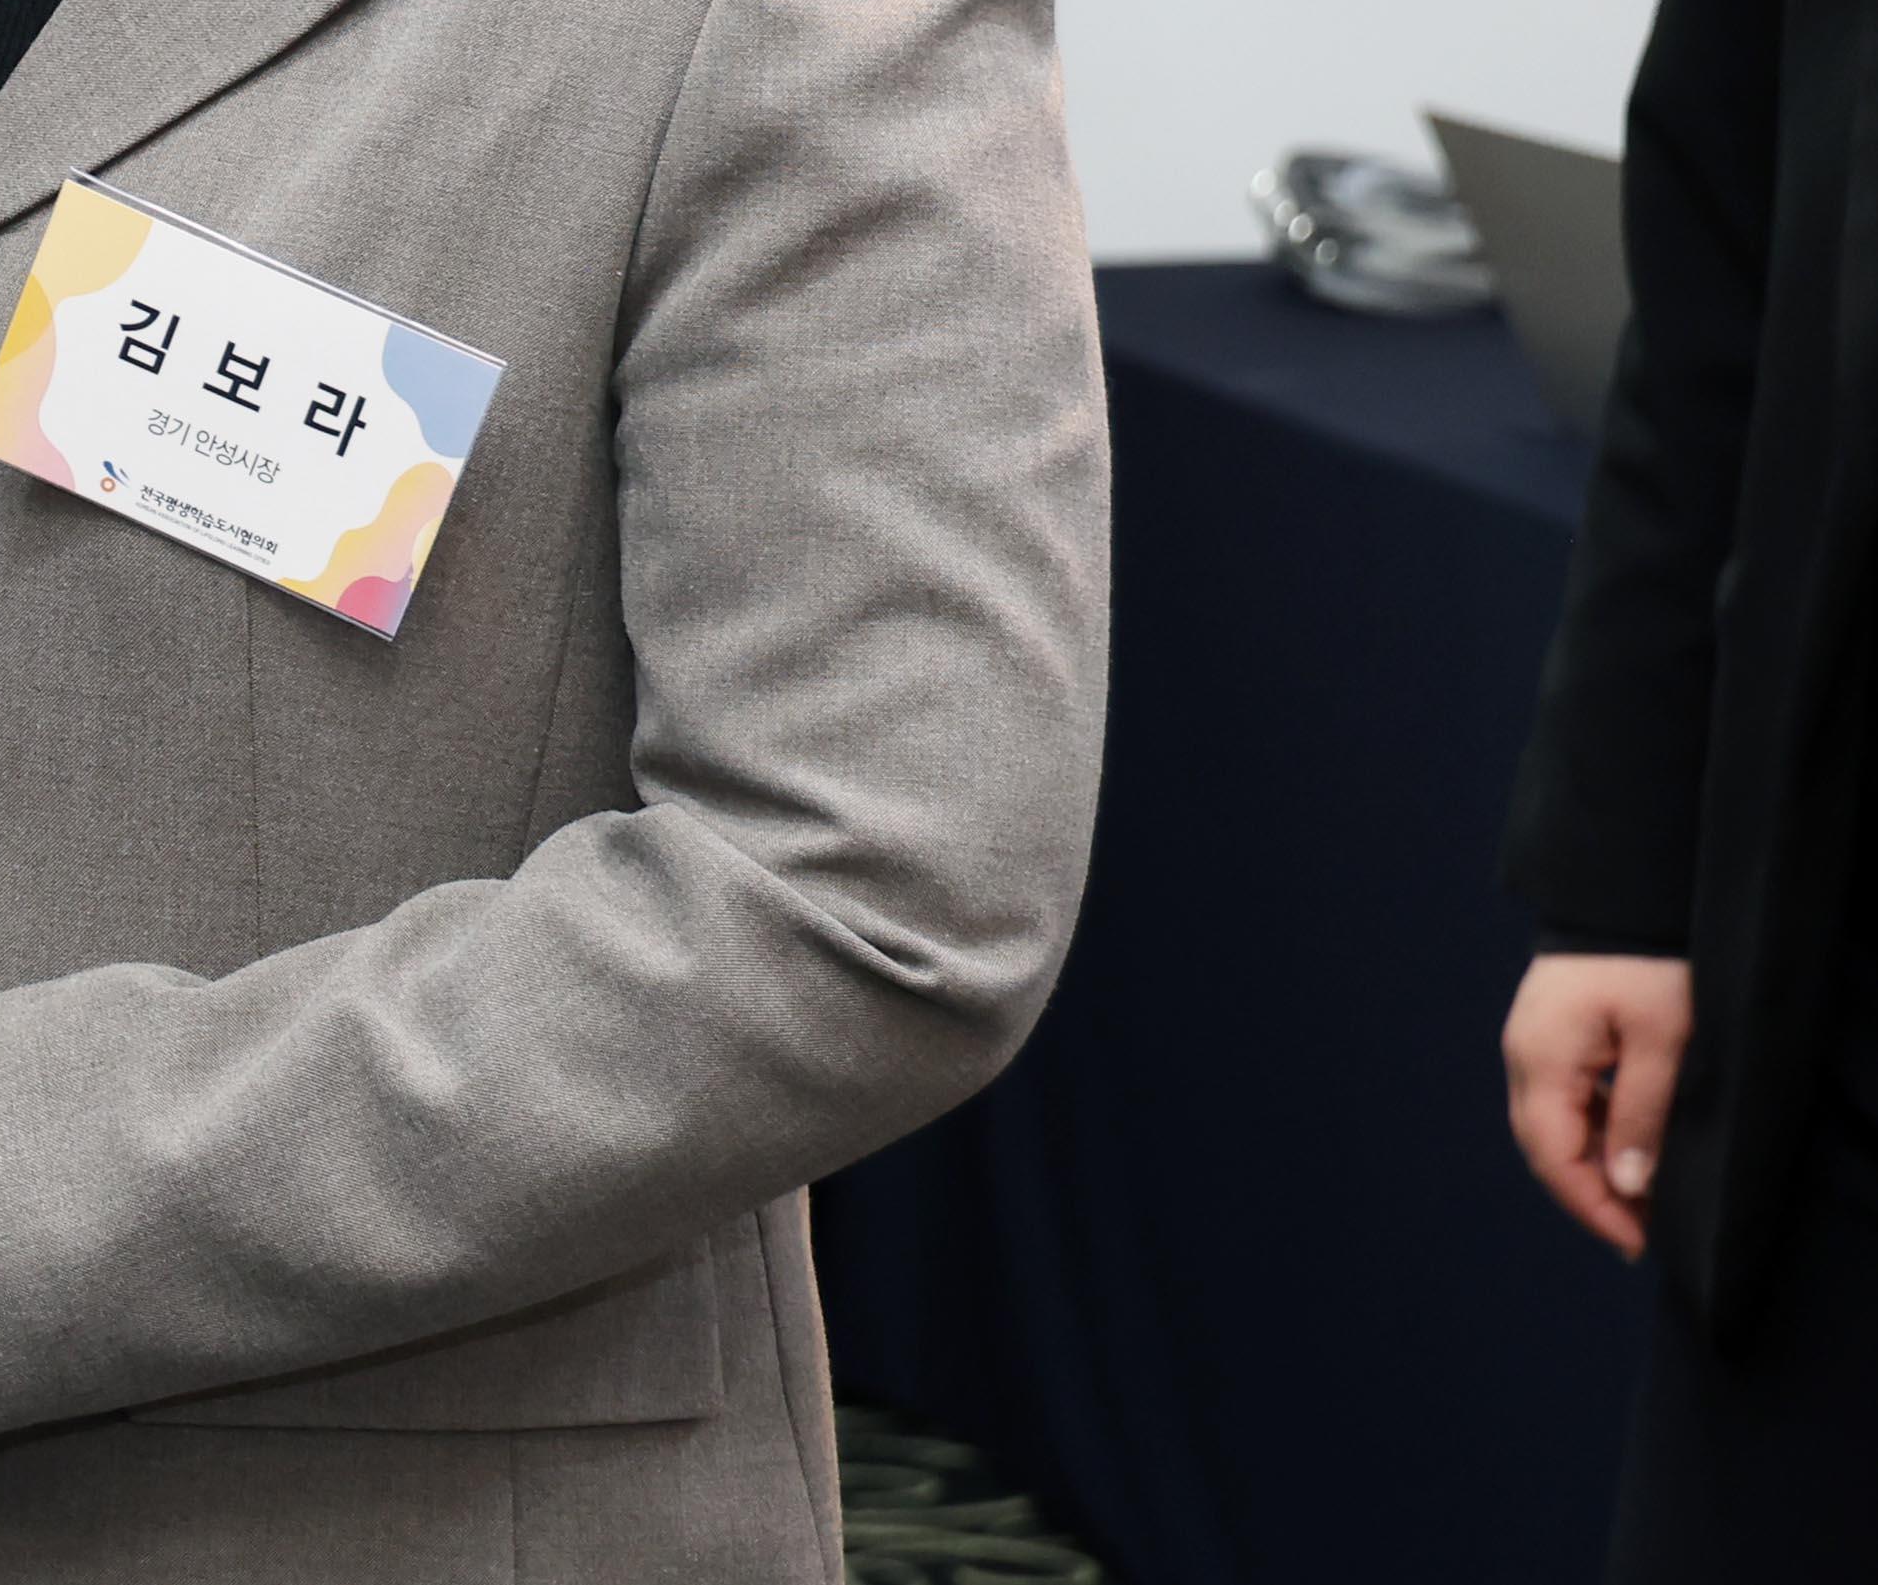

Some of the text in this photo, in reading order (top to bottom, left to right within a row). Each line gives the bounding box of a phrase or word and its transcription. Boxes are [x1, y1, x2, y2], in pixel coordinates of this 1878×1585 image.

[147, 408, 281, 485] 경기 안성시장
[140, 484, 279, 555] 전국평생학습도시협의회
